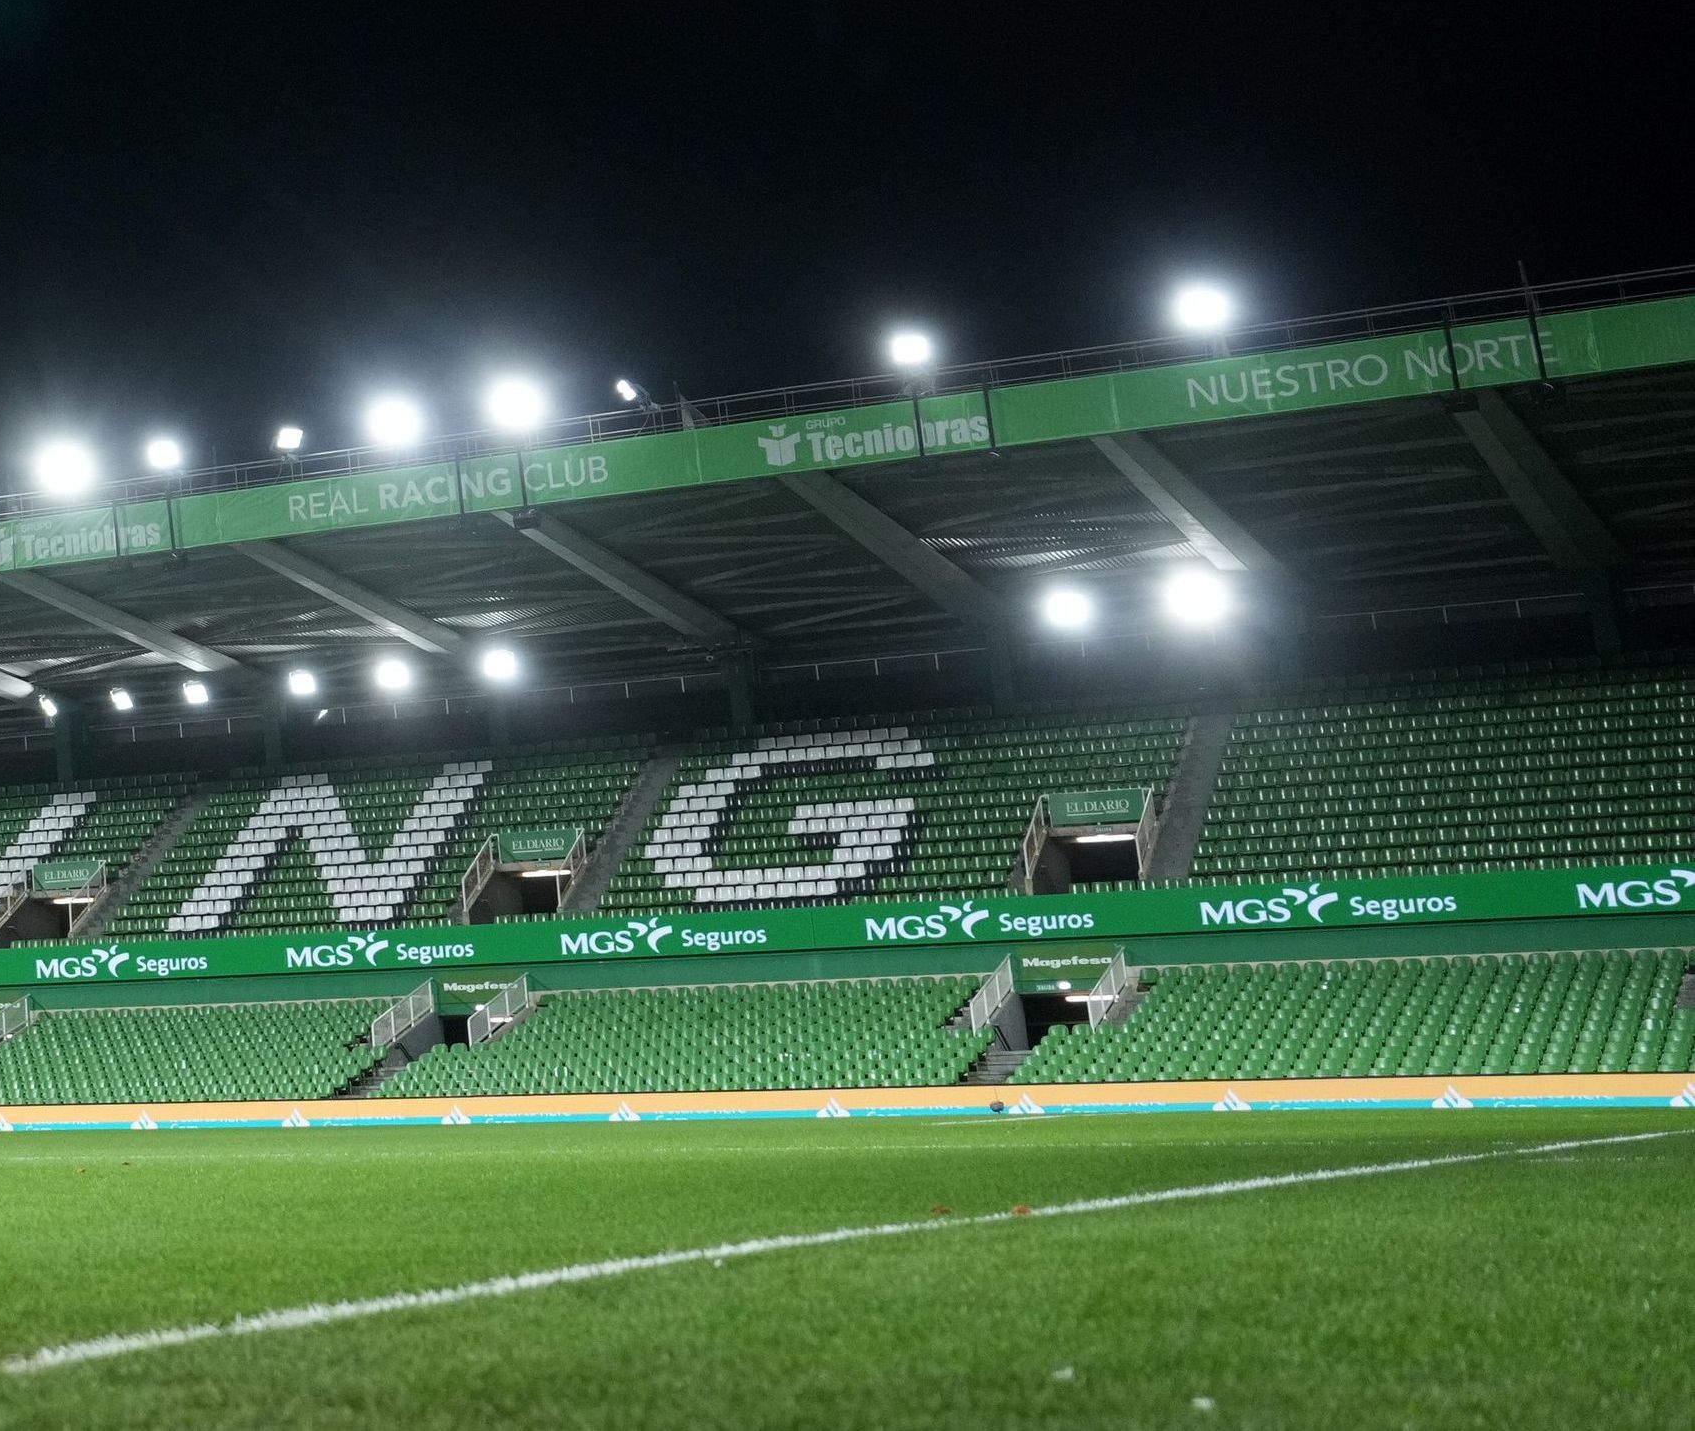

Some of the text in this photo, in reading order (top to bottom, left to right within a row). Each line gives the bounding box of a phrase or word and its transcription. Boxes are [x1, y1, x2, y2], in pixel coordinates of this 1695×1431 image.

[1185, 331, 1559, 408] NUESTRO NORTE
[805, 416, 846, 431] GRUPO
[805, 413, 990, 463] Tecniobras
[289, 455, 608, 523] REAL RACING CLUB
[22, 520, 161, 563] Tecniobras
[1066, 798, 1130, 813] EL DIARIO
[512, 836, 565, 851] EL DIARIO
[44, 867, 89, 881] EL DIARIO
[1576, 878, 1679, 909] MGS
[1200, 892, 1458, 926] MGS Seguros
[560, 925, 767, 955] MGS Seguros
[865, 910, 1094, 940] MGS Seguros
[36, 953, 208, 978] MGS Seguros
[286, 941, 475, 967] MGS Seguros
[1022, 956, 1112, 968] Magefesa
